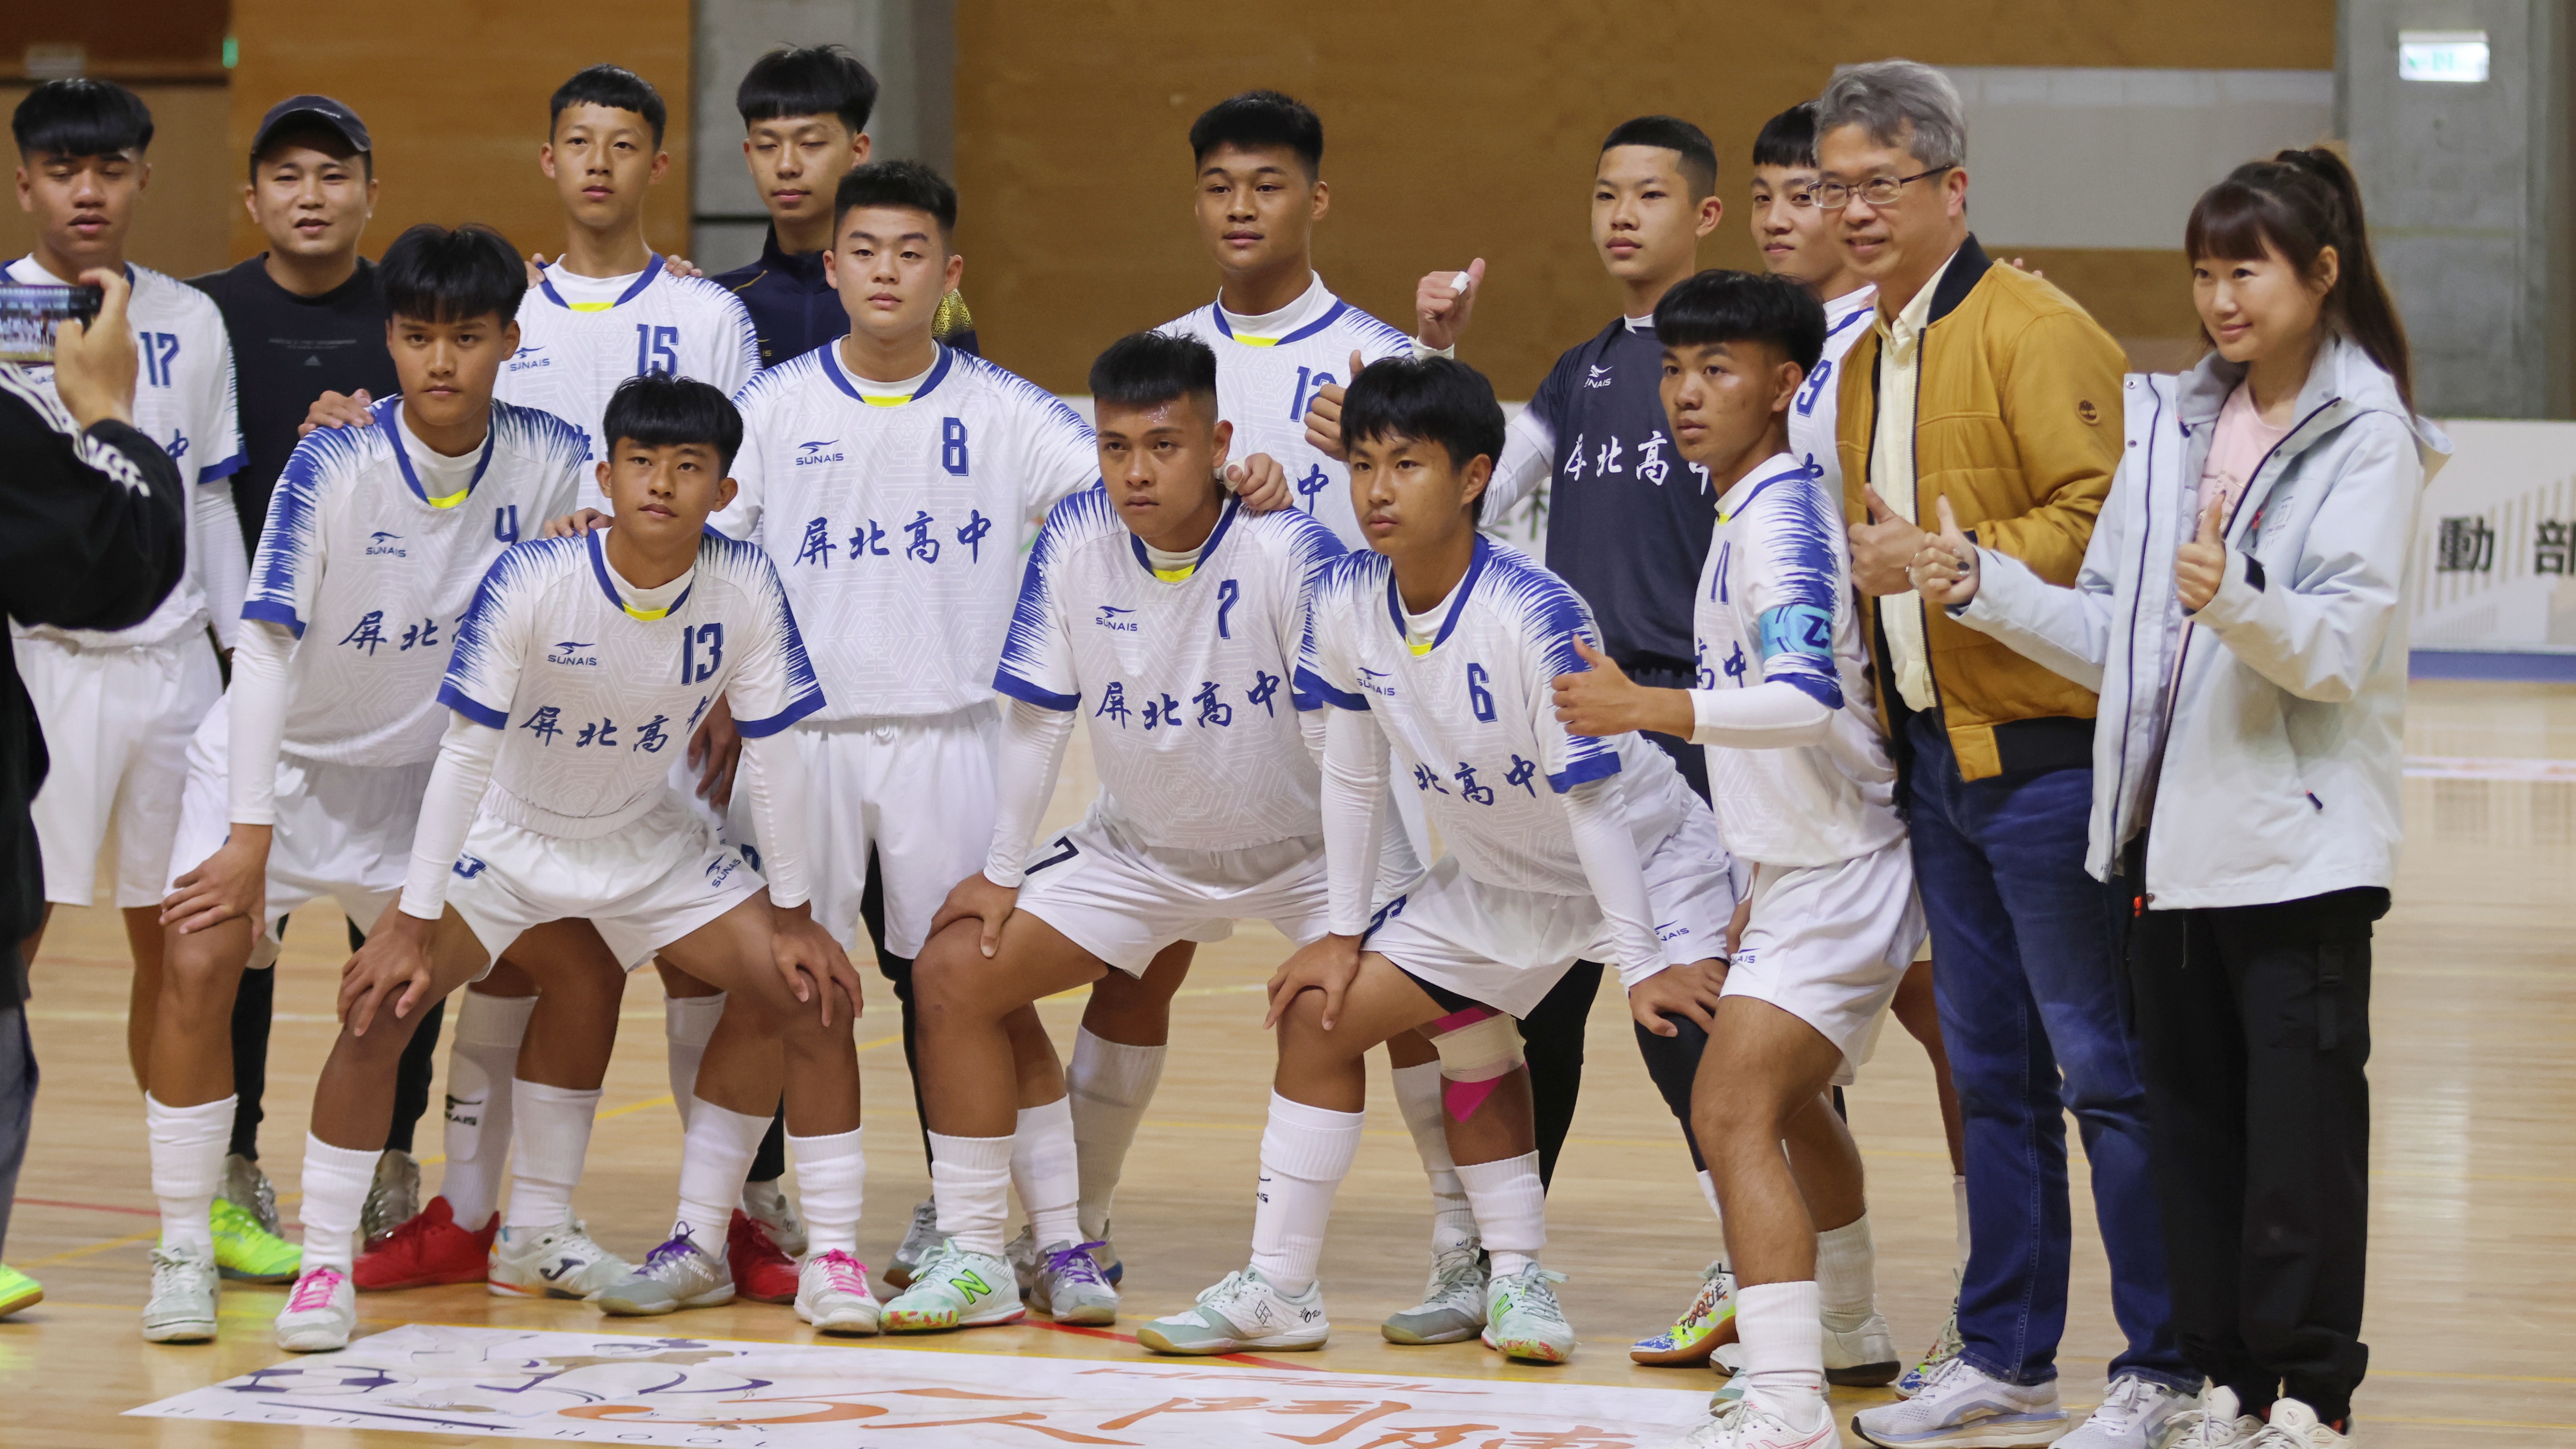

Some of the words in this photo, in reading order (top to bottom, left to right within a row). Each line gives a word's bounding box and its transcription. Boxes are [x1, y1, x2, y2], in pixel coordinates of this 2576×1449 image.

[140, 332, 179, 387] 17
[636, 323, 678, 376] 15
[795, 452, 844, 465] SUNAIS
[942, 417, 969, 476] 8
[365, 546, 406, 558] SUNAIS
[793, 509, 991, 569] 屏北高中
[338, 610, 467, 657] 屏北
[1095, 617, 1138, 632] SUNAIS
[1217, 579, 1240, 640] 7
[547, 654, 597, 666] SUNAIS
[680, 623, 724, 686] 13
[1095, 670, 1280, 730] 屏北高中
[1467, 663, 1497, 723] 6
[712, 859, 741, 888] SUNAIS
[1024, 836, 1079, 876] 7
